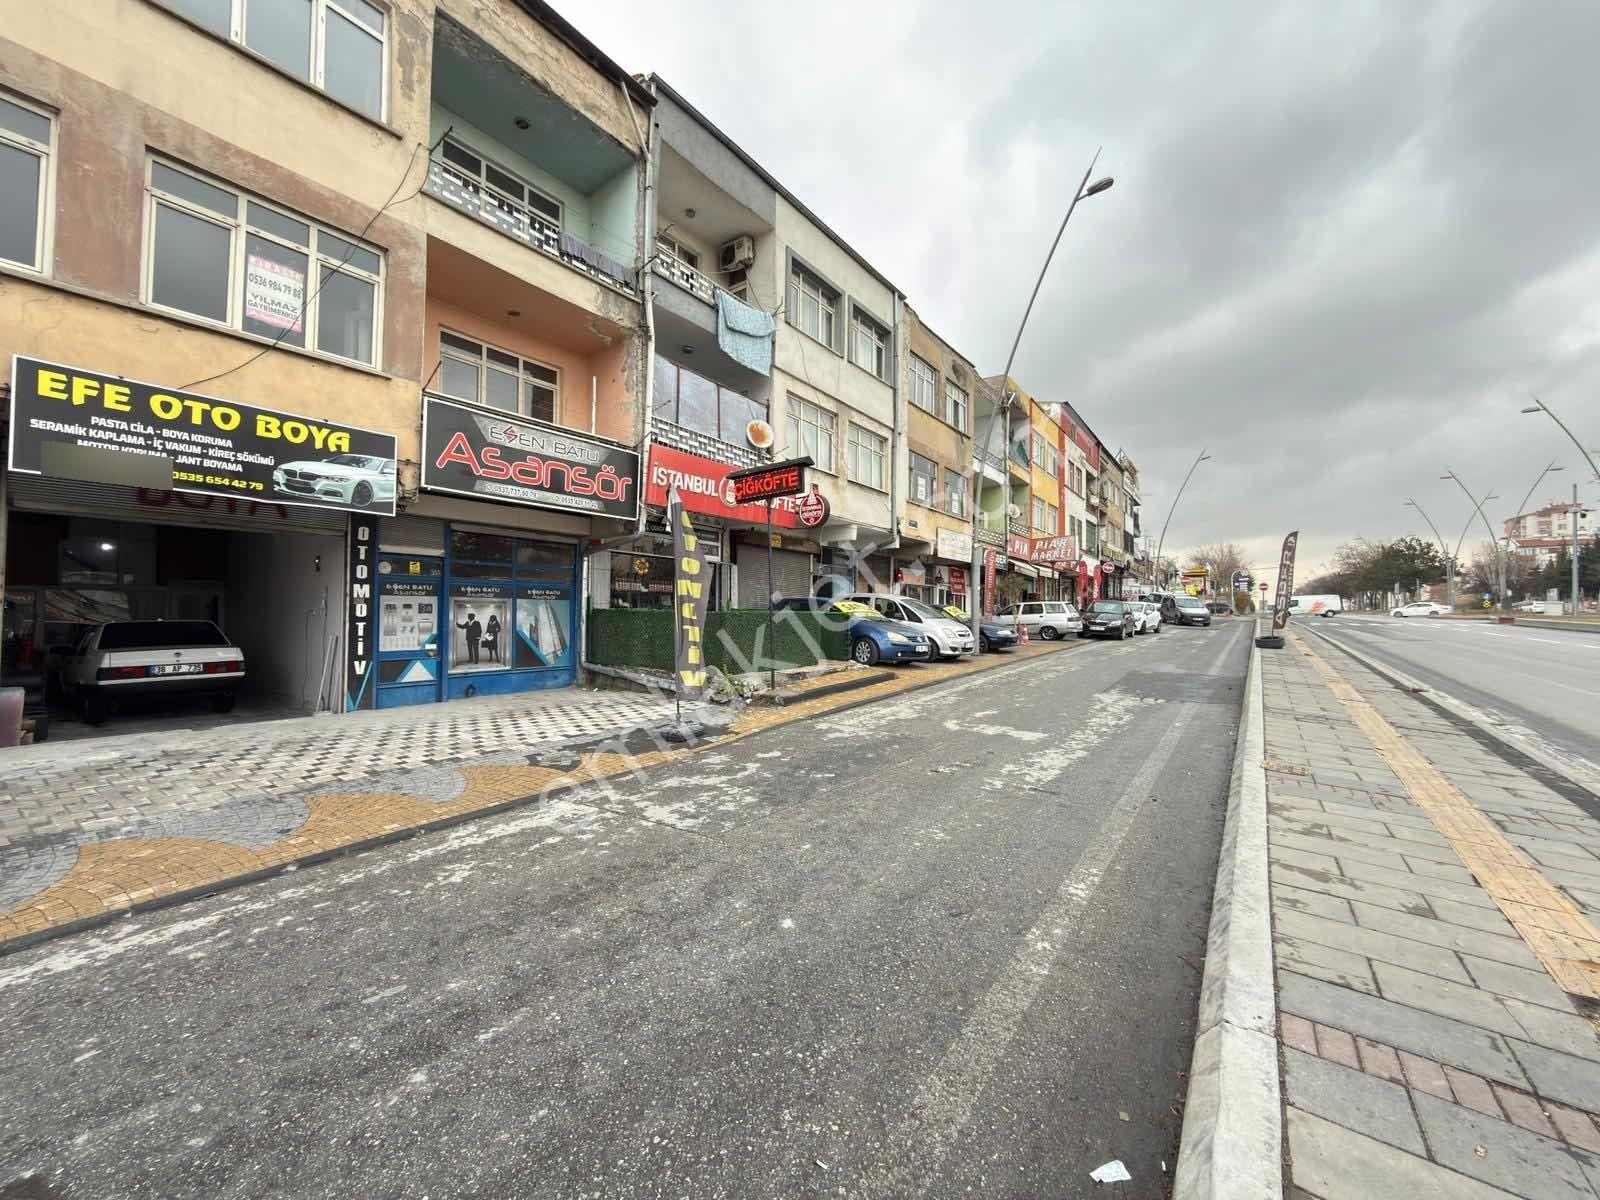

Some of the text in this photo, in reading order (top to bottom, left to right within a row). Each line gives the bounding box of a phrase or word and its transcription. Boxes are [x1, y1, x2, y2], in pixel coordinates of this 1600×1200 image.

[36, 369, 351, 453] EFE OTO BOYA
[29, 418, 88, 437] SERAMİK
[88, 428, 145, 446] KAPLAMA
[153, 437, 164, 450] İÇ
[165, 440, 201, 455] VAKUM
[208, 446, 236, 462] KİREÇ
[237, 451, 275, 466] SÖKÜMÜ
[90, 416, 129, 431] PASTA
[130, 421, 154, 435] CİLA
[162, 428, 190, 441] BOYA
[191, 433, 233, 448] KORUMA
[175, 454, 202, 466] JANT
[203, 460, 243, 472] BOYAMA
[436, 431, 633, 502] Asansör
[553, 441, 600, 462] BATU
[205, 475, 230, 486] 654
[231, 478, 247, 489] 42
[249, 481, 264, 491] 79
[652, 462, 719, 497] İSTANBUL
[352, 526, 371, 675] OTOMOTİV
